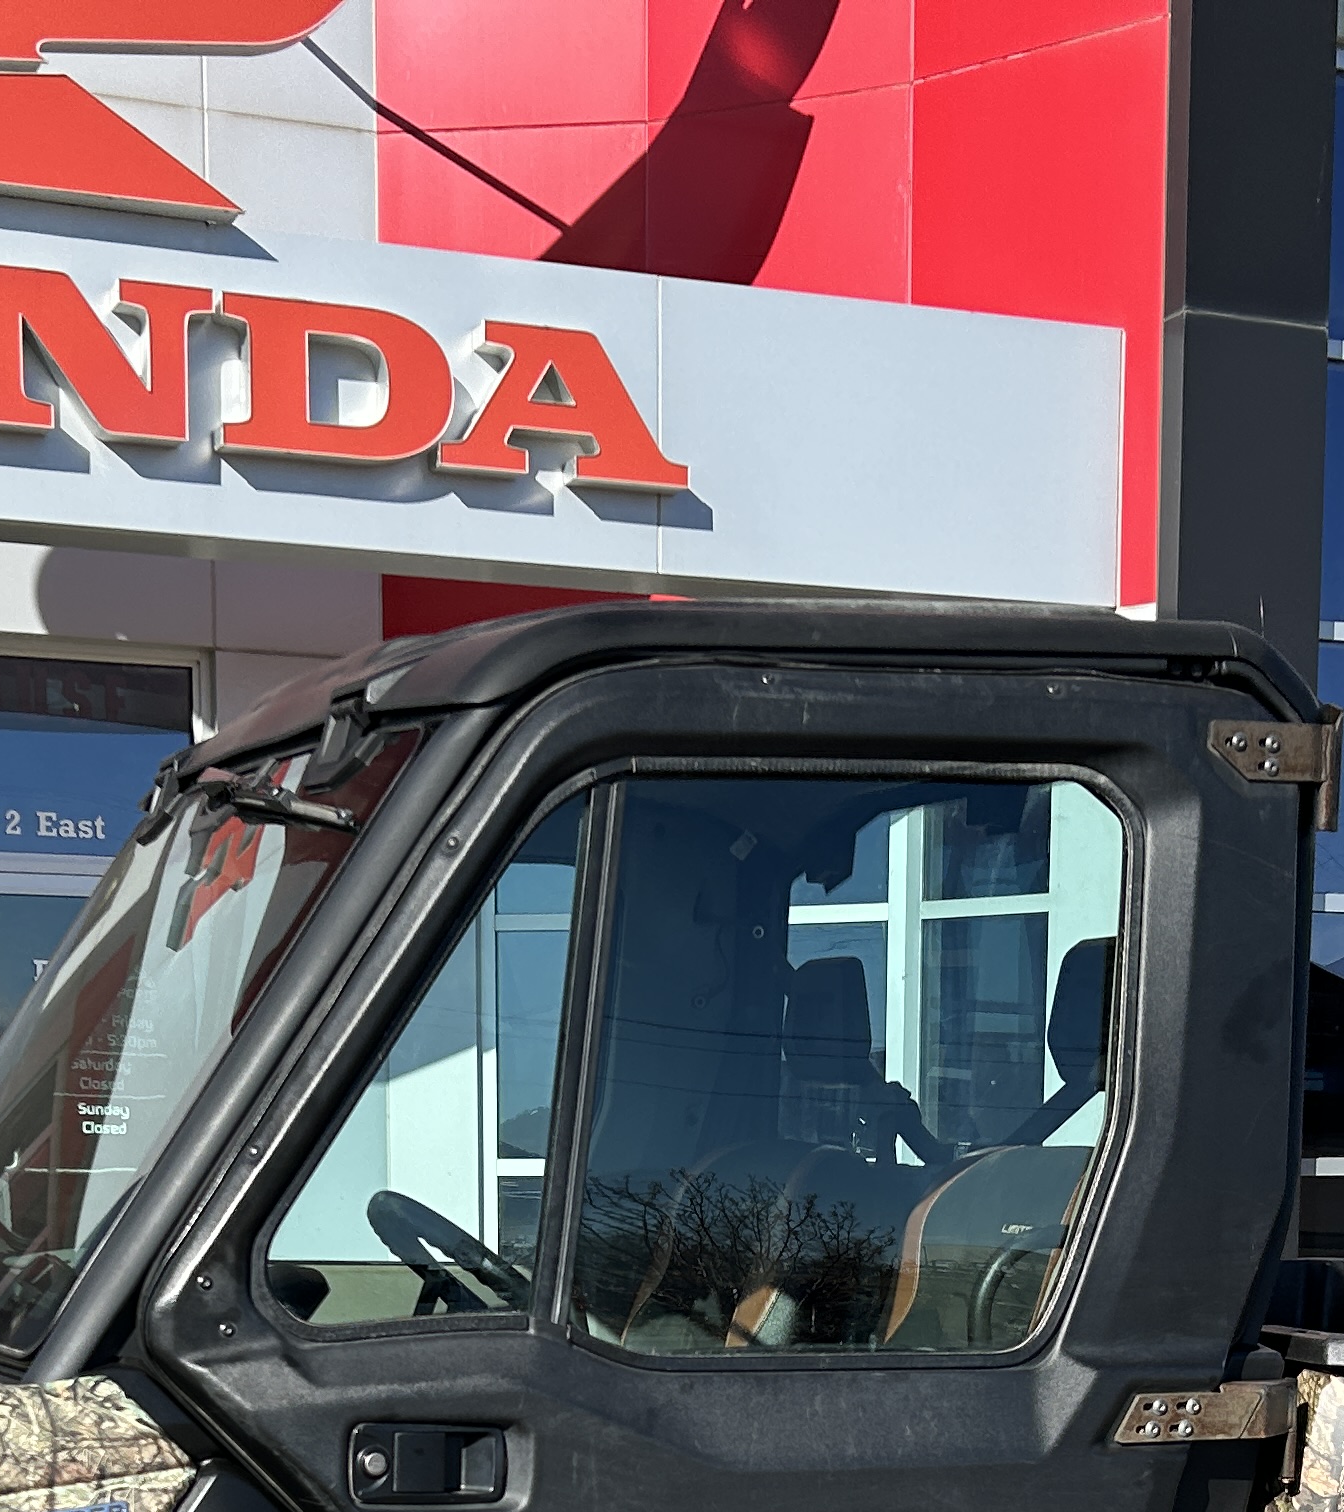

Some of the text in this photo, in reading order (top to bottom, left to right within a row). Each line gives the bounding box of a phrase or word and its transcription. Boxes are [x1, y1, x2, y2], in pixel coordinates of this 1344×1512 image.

[4, 809, 22, 836] 2
[35, 811, 106, 840] East
[111, 1014, 154, 1033] Friday
[70, 1058, 132, 1074] Saturday
[79, 1077, 125, 1092] Closed
[77, 1102, 131, 1120] Sunday
[81, 1121, 127, 1136] Closed
